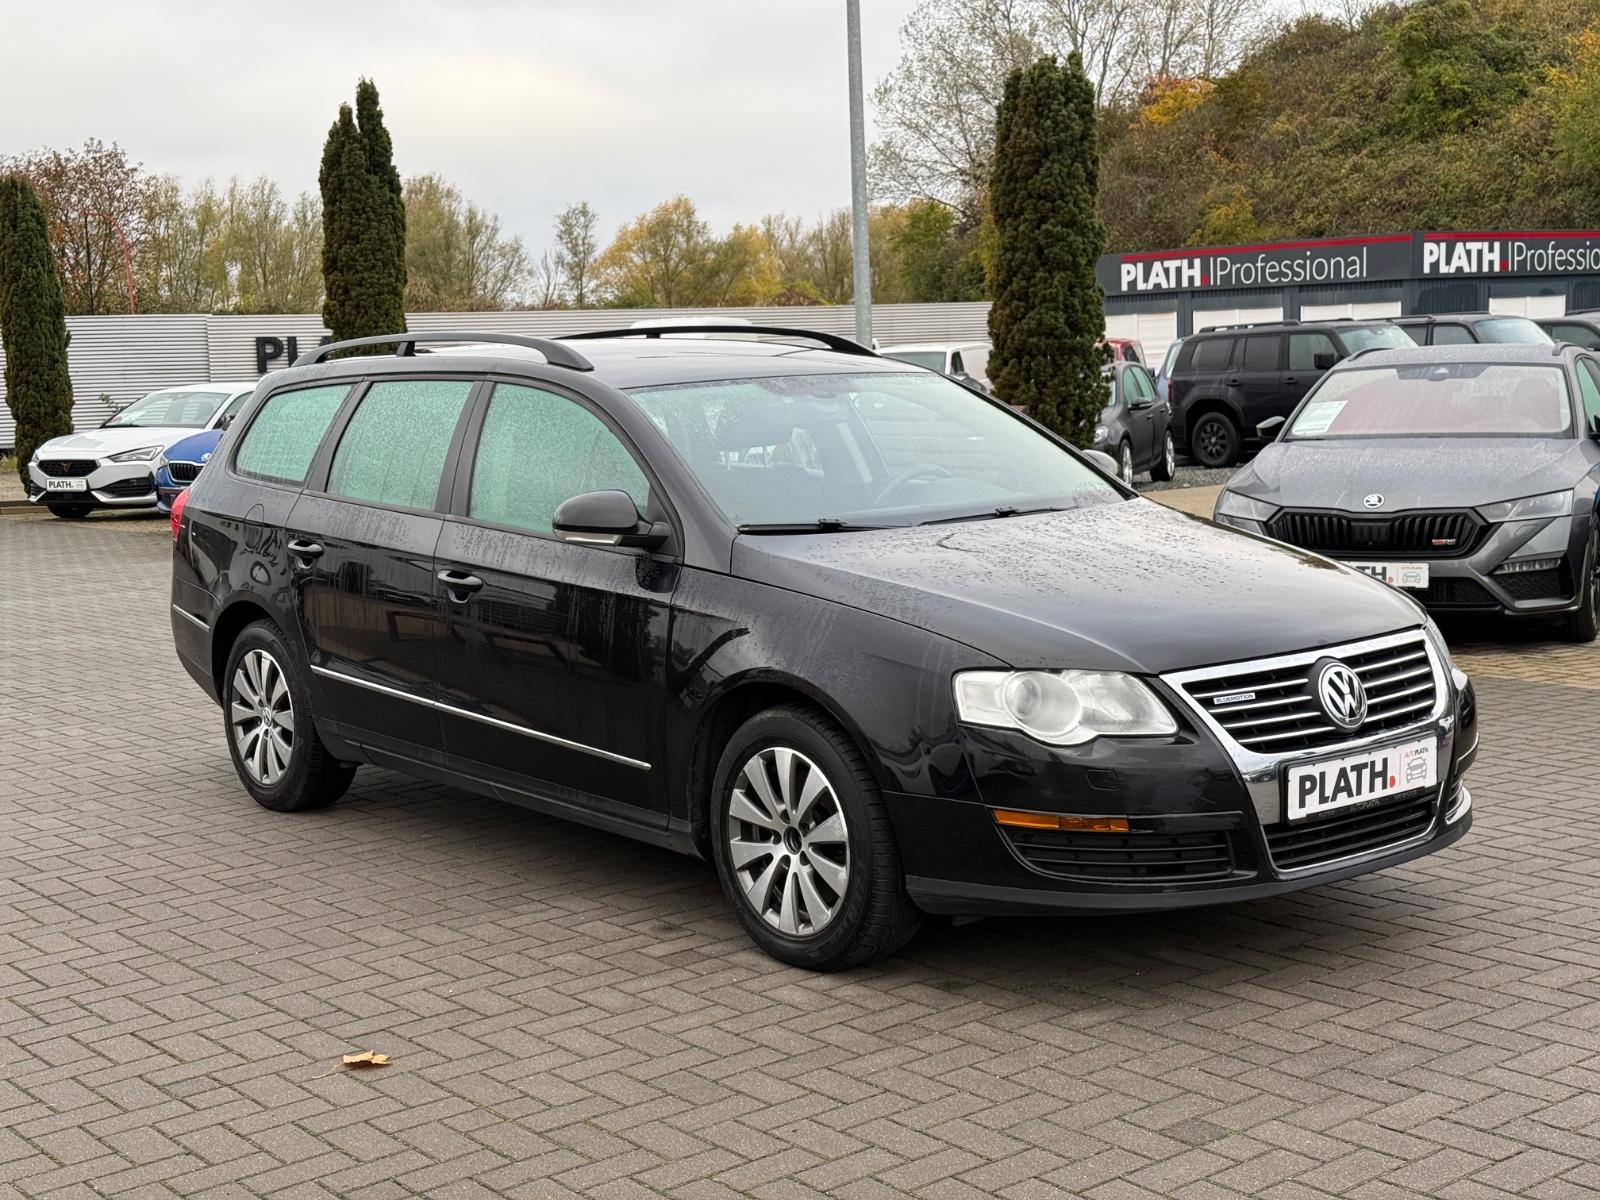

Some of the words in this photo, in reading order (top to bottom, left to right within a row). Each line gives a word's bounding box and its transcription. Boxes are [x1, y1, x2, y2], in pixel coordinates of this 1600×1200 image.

[1120, 258, 1209, 292] PLATH.
[1423, 241, 1508, 275] PLATH.
[1215, 694, 1254, 703] BLUEMOTION
[1298, 757, 1396, 809] PLATH.
